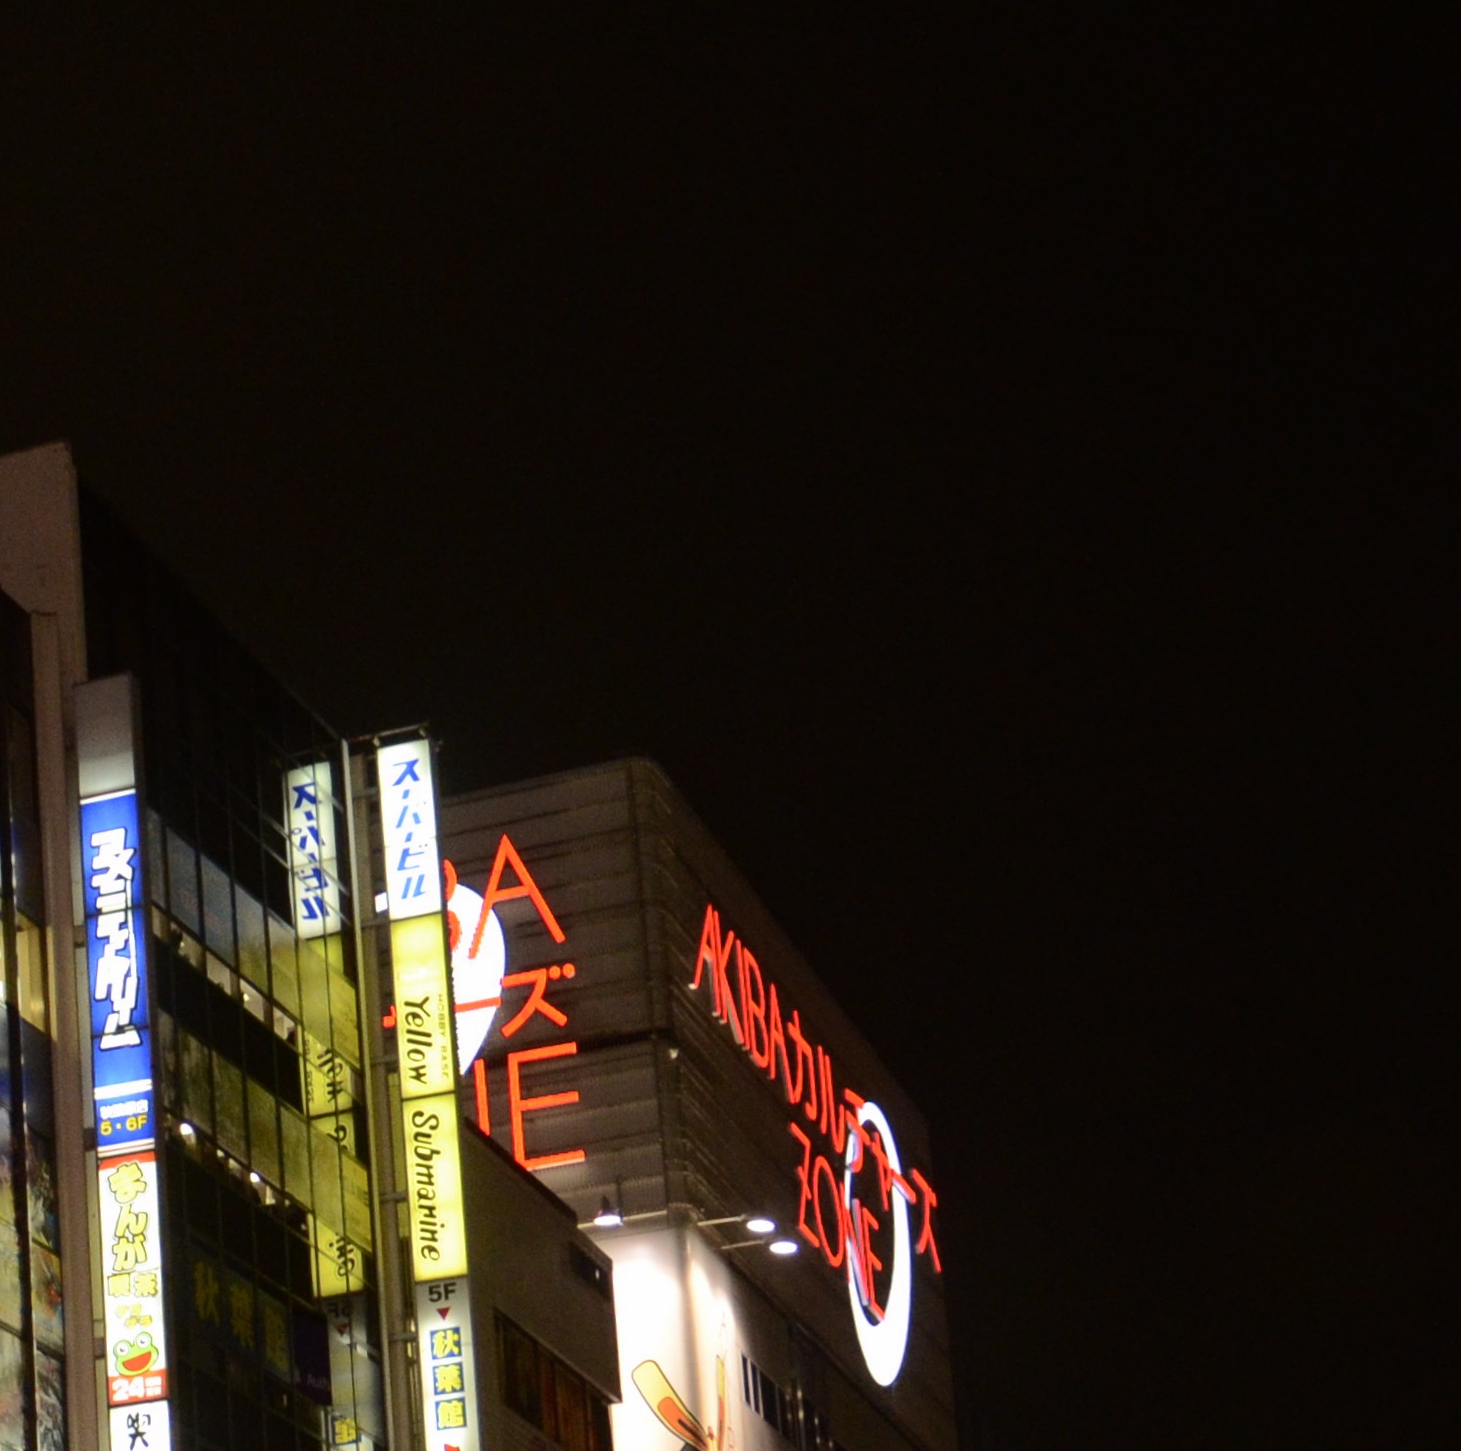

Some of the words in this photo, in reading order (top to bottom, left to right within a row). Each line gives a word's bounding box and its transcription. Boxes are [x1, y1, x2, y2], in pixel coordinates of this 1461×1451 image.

[404, 995, 433, 1085] Yellow
[108, 1161, 149, 1272] まんが
[411, 1109, 445, 1262] Submarine
[789, 1121, 886, 1322] ZONE
[427, 1282, 457, 1303] 5F
[112, 1377, 138, 1401] 24
